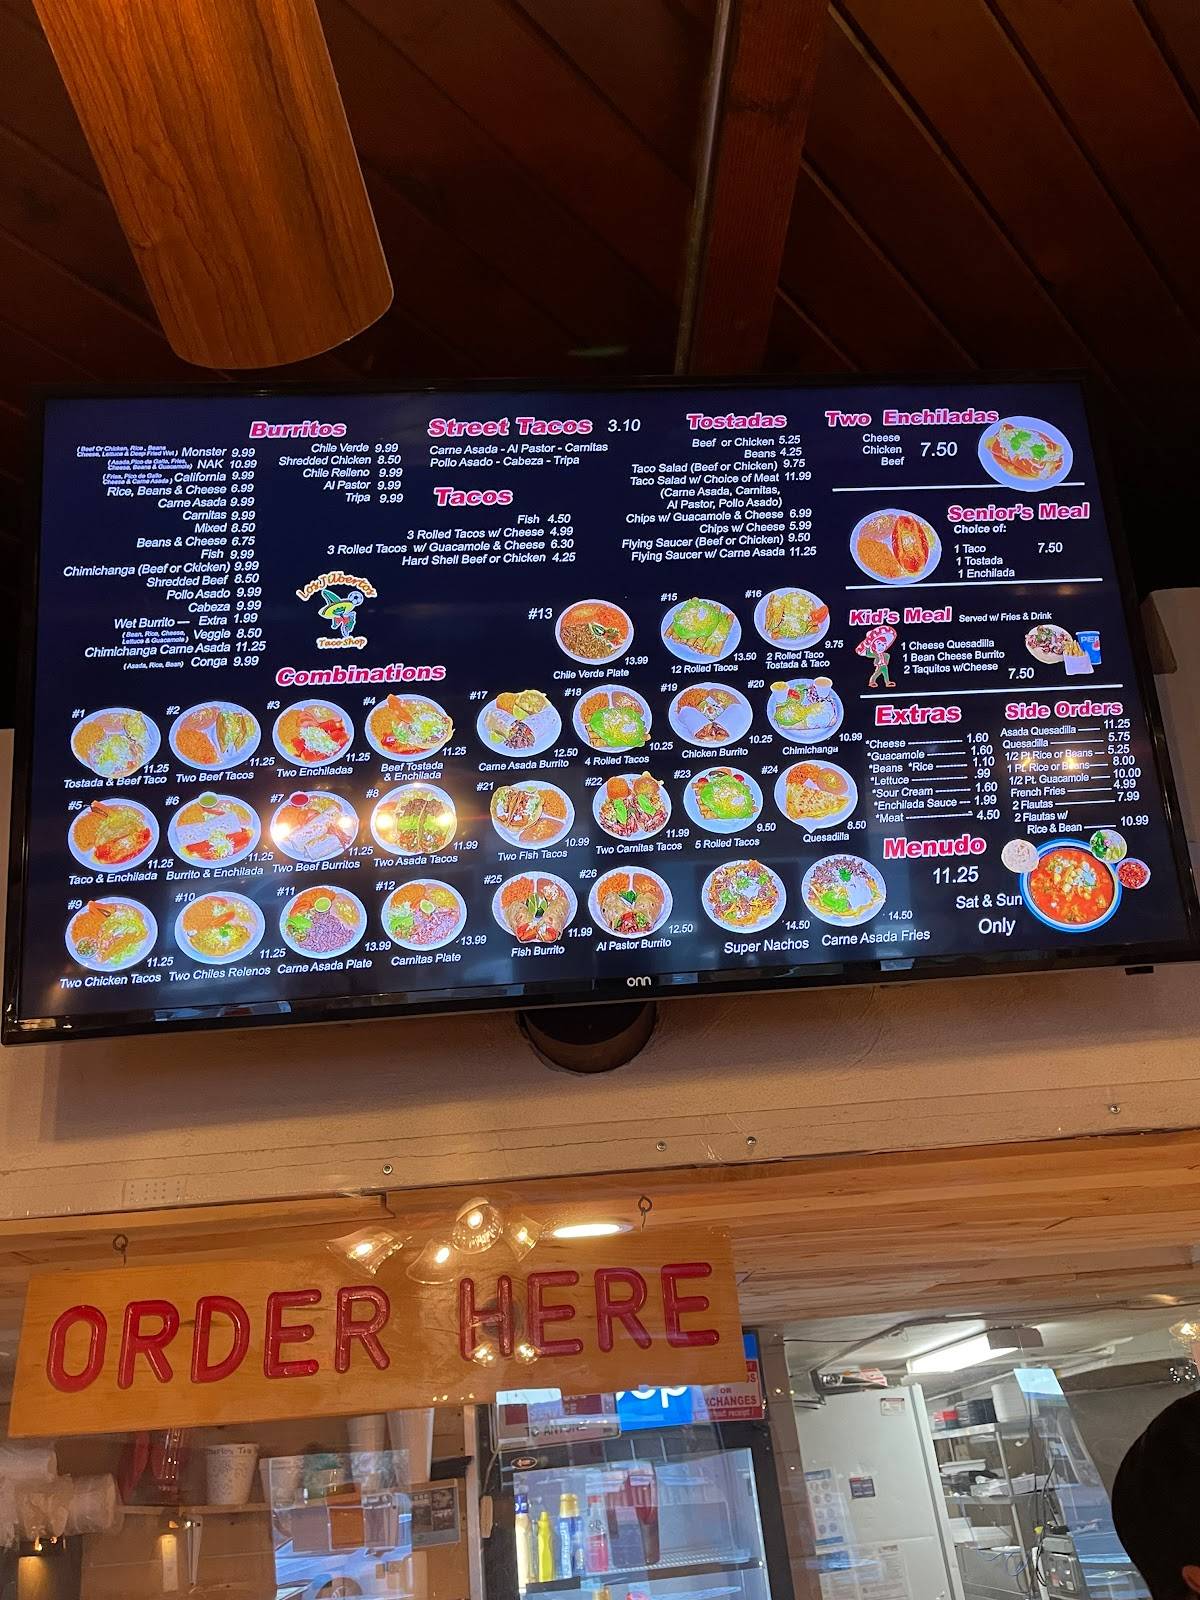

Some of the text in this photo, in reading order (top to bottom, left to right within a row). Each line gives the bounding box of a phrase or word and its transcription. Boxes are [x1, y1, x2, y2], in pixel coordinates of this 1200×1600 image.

[686, 412, 787, 430] Tostadas
[824, 408, 999, 427] Two Enchiladas
[249, 420, 347, 439] Burritos
[427, 417, 640, 437] Street Tacos 3.10
[692, 438, 717, 447] Beef
[734, 437, 774, 446] Chicken
[779, 435, 800, 444] 5.25
[862, 433, 900, 442] Cheese
[181, 447, 255, 458] Monster 9.99
[311, 443, 398, 453] Chile Verde 9.99
[744, 447, 802, 458] Beans 4.25
[862, 441, 958, 457] Chicken 7.50
[197, 459, 257, 469] NAK 10.99
[278, 454, 401, 466] Shredded Chicken 8.50
[881, 456, 905, 466] Beef
[174, 471, 254, 482] California 9.99
[630, 471, 812, 485] Taco Salad w/ Choice of Meat 11.99
[107, 483, 254, 497] Rice, Beans & Cheese 6.99
[323, 480, 401, 490] Al Pastor 9.99
[345, 492, 404, 504] Tripa 9.99
[433, 487, 513, 507] Tacos
[183, 510, 256, 521] Carnitas 9.99
[517, 514, 571, 524] Fish 4.50
[947, 502, 1090, 522] Senior's Meal
[407, 526, 573, 540] 3 Rolled Tacos w/ Cheese 4.99
[699, 521, 812, 535] Chips w/ Cheese 5.99
[954, 523, 1006, 534] Choice of:
[954, 542, 1063, 553] 1 Taco 7.50
[402, 555, 429, 566] Hard
[431, 554, 459, 565] Shell
[461, 554, 488, 564] Beef
[503, 552, 546, 563] Chicken
[552, 552, 576, 562] 4.25
[956, 556, 1003, 566] 1 Tostada
[146, 573, 260, 587] Shredded Beef 8.50
[958, 568, 1015, 578] 1 Enchilada
[166, 586, 262, 600] Pollo Asado 9.99
[528, 608, 552, 620] #13
[849, 606, 952, 626] Kid's Meal
[194, 628, 262, 641] Veggie 8.50
[901, 639, 994, 650] 1 Cheese Quesadilla
[553, 656, 648, 679] Chile Verde Plate 13.99
[671, 652, 757, 674] 12 Rolled Tacos 13.50
[275, 663, 447, 687] Combinations
[1008, 667, 1034, 679] 7.50
[875, 704, 962, 726] Extras
[1005, 700, 1123, 720] Side Orders
[967, 732, 989, 743] 1.60
[971, 745, 993, 755] 1.60
[64, 763, 170, 788] Tostada & Beef Taco 11.25
[974, 768, 990, 779] .99
[1011, 778, 1136, 797] French Fries 4.99
[498, 837, 590, 861] Two Fish Tacos 10.99
[883, 833, 987, 860] Menudo
[933, 866, 979, 884] 11.25
[956, 894, 1022, 909] Sat & Sun
[860, 910, 930, 944] Asada Fries 14.50
[978, 917, 1016, 936] Only
[724, 919, 810, 955] Super Nachos 14.50
[821, 934, 857, 946] Carne
[60, 956, 174, 989] Two Chicken Tacos 11.25
[627, 975, 651, 987] onn
[47, 1261, 721, 1394] ORDER HERE
